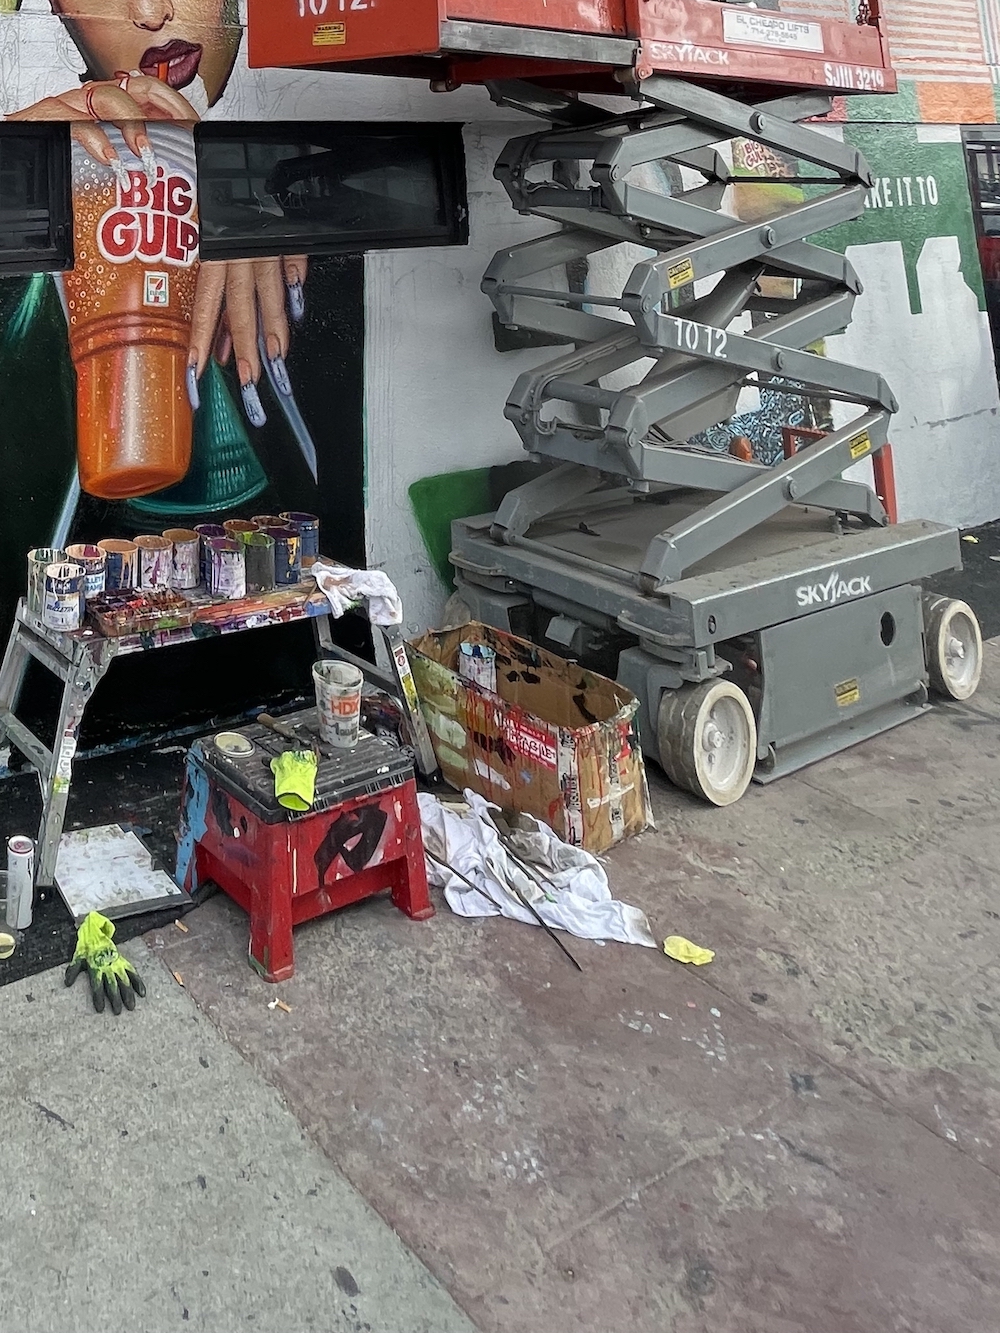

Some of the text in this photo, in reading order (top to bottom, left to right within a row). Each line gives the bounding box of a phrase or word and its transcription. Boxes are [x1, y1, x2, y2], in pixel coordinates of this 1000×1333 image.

[896, 176, 913, 207] IT
[916, 174, 939, 206] TO
[796, 570, 872, 607] SKYJACK
